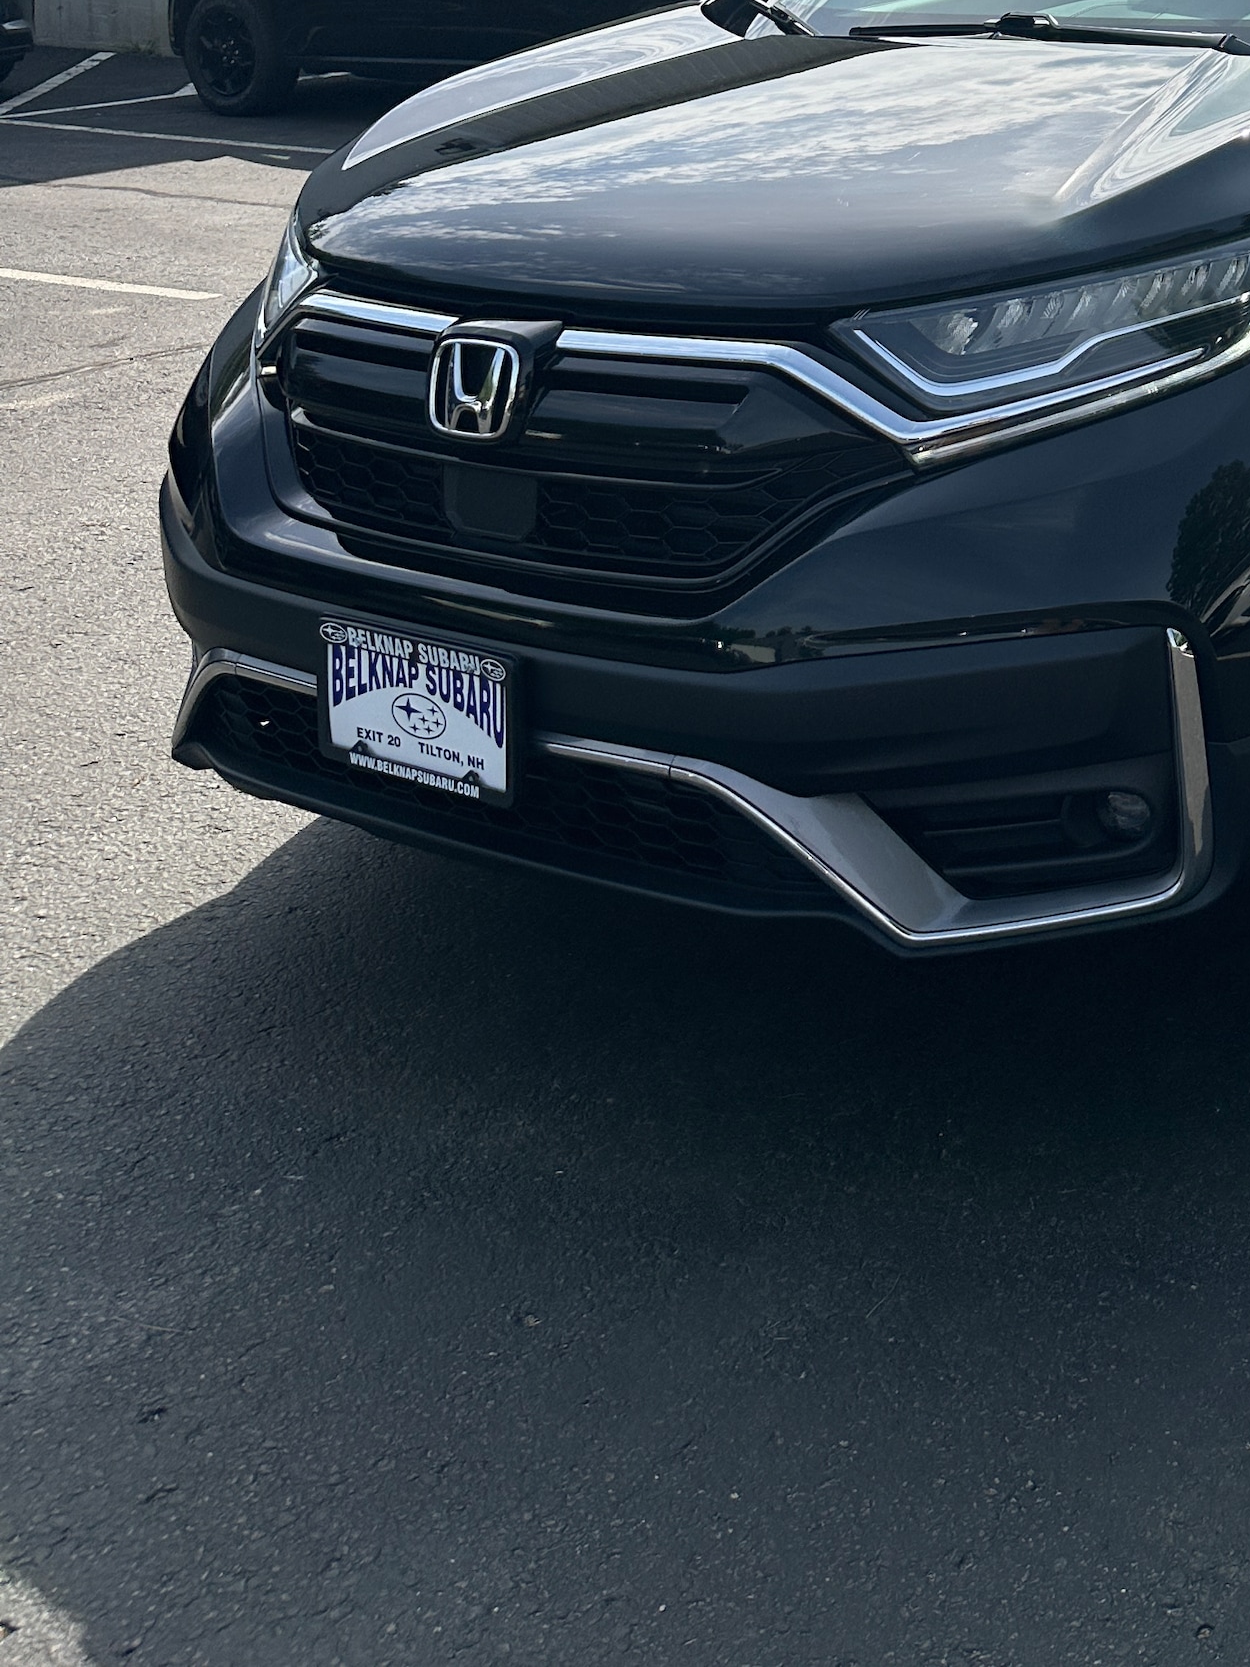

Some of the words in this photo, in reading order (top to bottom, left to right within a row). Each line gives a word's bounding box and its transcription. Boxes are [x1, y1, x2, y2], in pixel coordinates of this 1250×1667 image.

[347, 627, 414, 660] BELKNAP
[418, 643, 481, 676] SUBARU
[332, 645, 419, 707] BELKNAP
[425, 665, 505, 748] SUBARU
[356, 727, 383, 743] EXIT
[387, 735, 401, 747] 20
[418, 741, 464, 766] TILTON,
[467, 755, 485, 770] NH
[350, 751, 480, 799] WWW.BELKNAPSUBARU.COM
